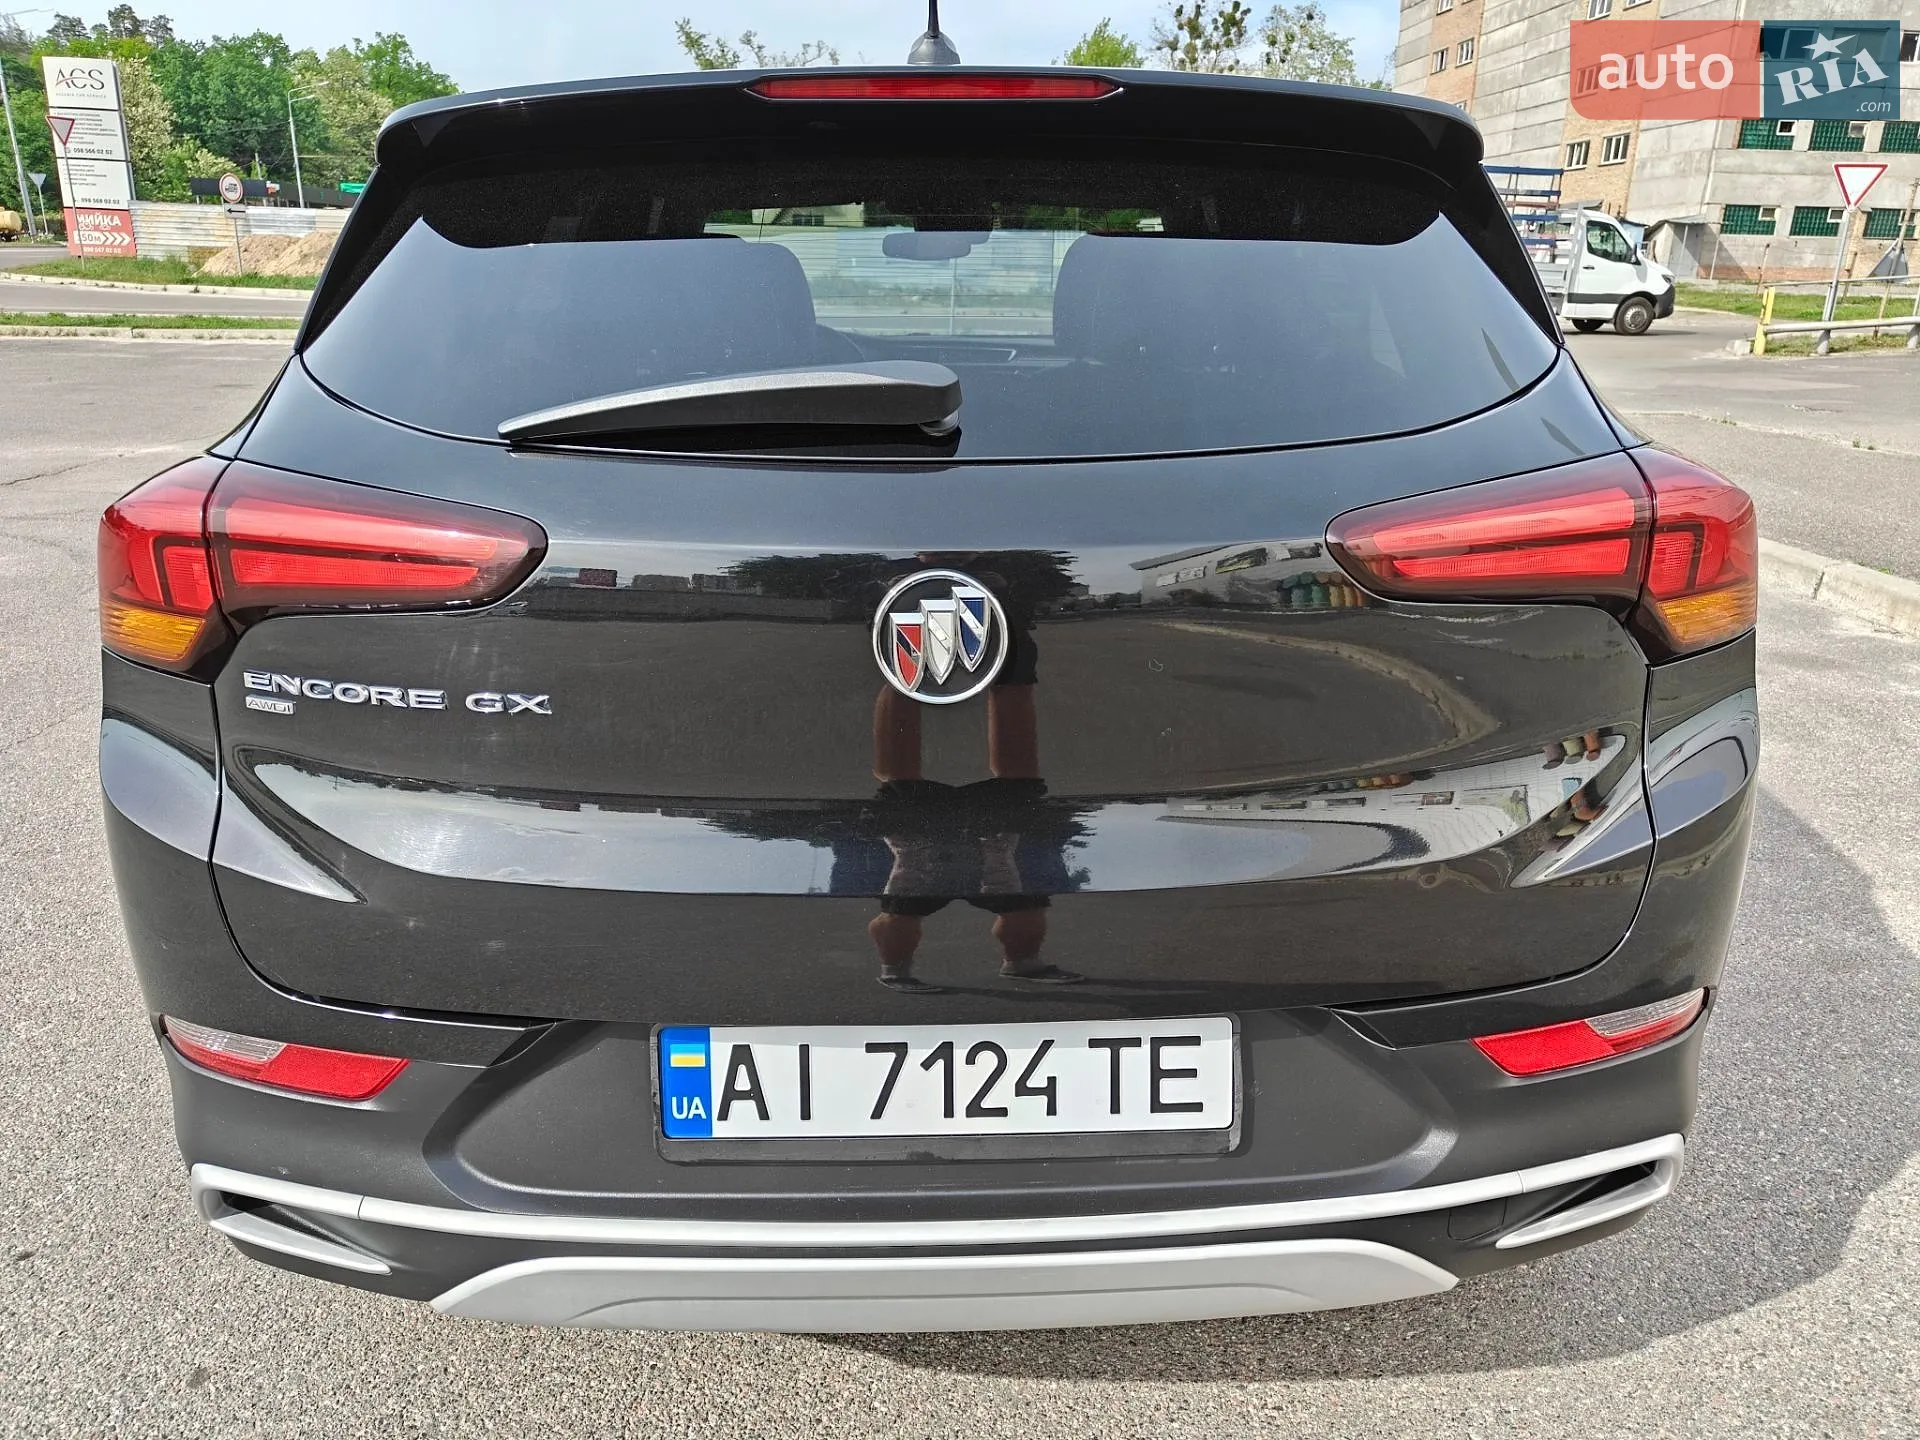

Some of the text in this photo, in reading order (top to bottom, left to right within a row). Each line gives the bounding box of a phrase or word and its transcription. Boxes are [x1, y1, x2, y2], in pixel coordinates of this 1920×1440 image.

[56, 68, 105, 90] ACS
[243, 670, 552, 714] ENCORE GX
[716, 1036, 1204, 1121] AI 7124 TE
[671, 1096, 707, 1120] UA
